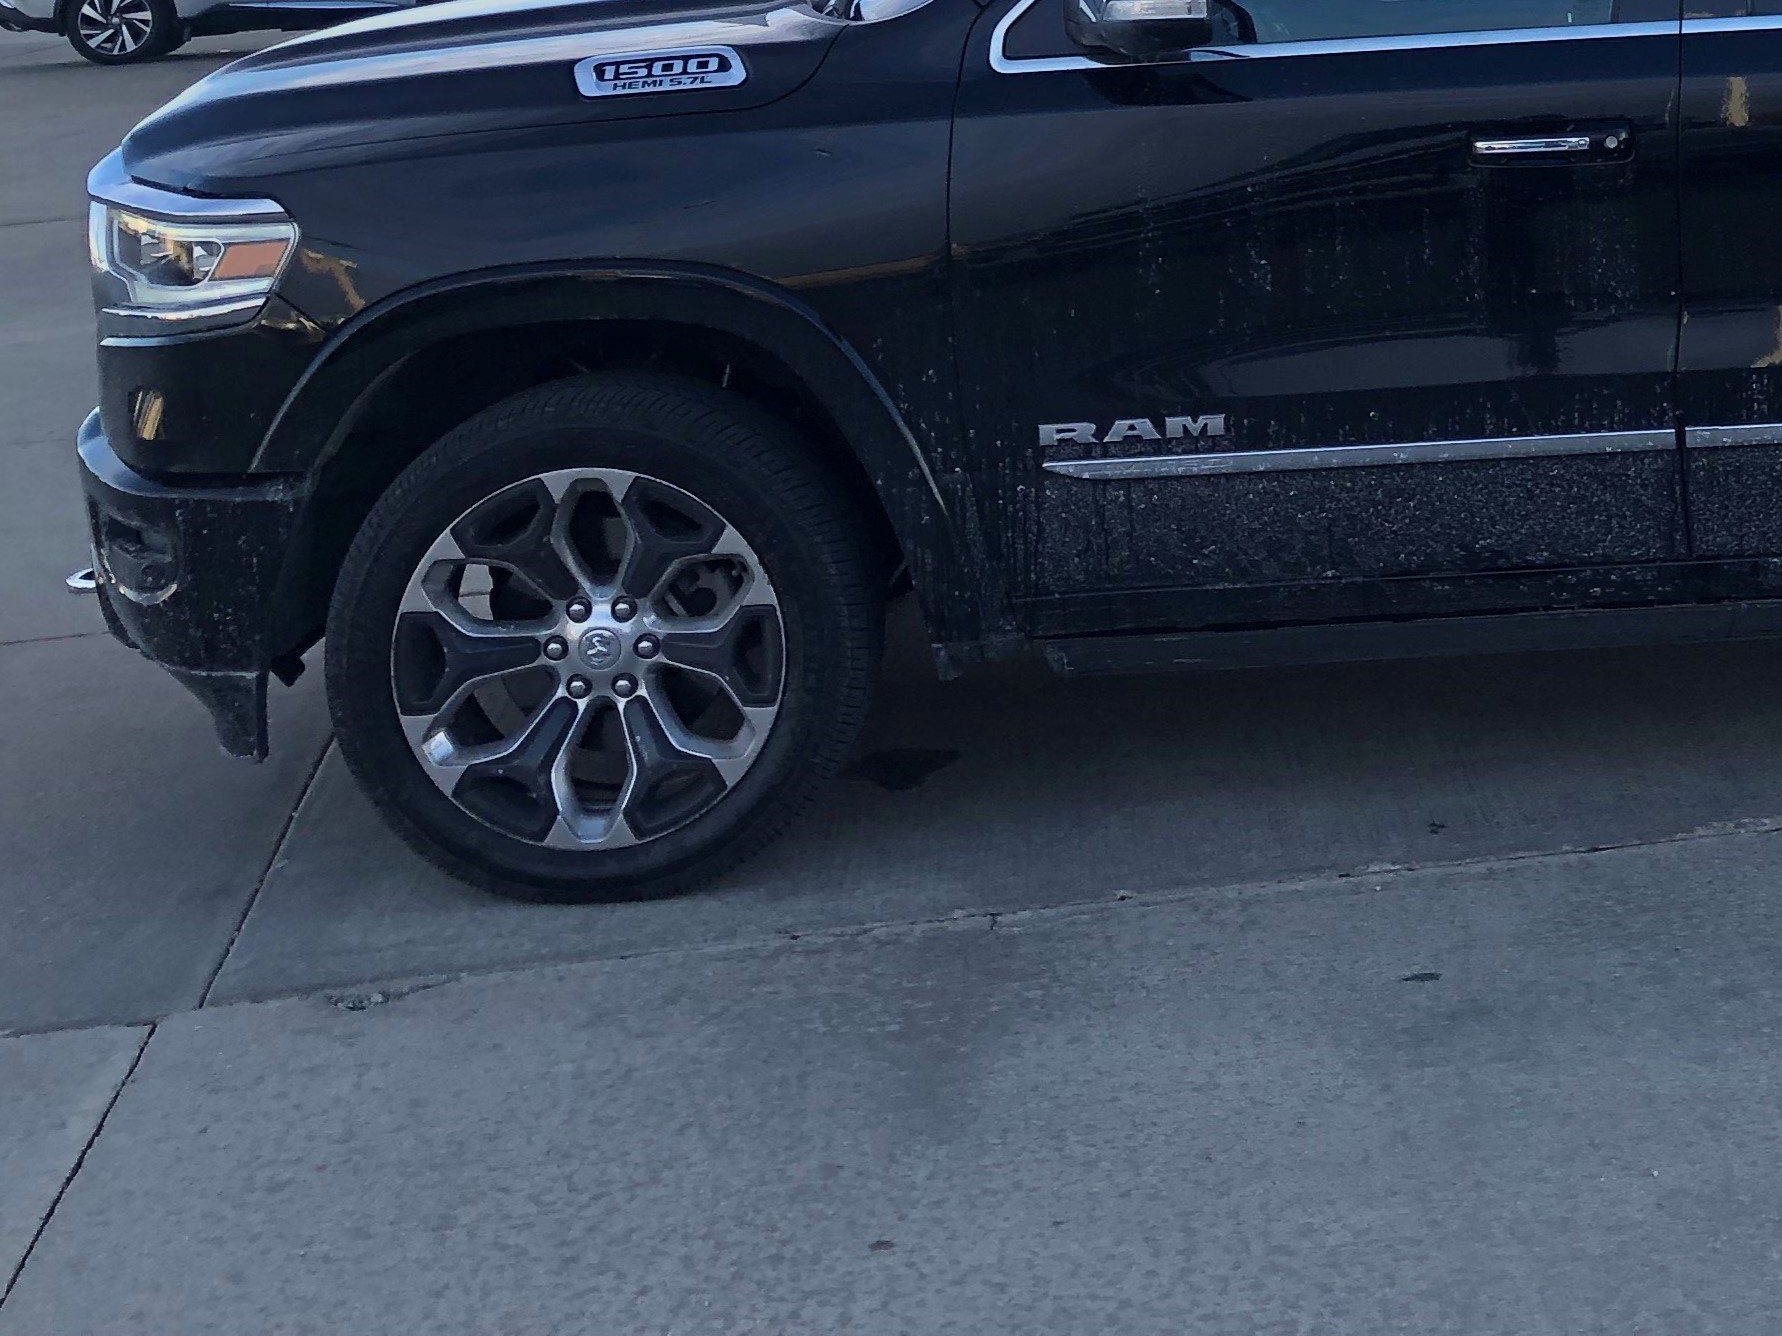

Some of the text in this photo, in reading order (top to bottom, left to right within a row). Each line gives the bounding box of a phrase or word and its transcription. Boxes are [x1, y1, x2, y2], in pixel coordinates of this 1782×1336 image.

[601, 56, 720, 80] 1500
[612, 75, 713, 91] HEMI 5.7L
[1038, 413, 1226, 447] RAM
